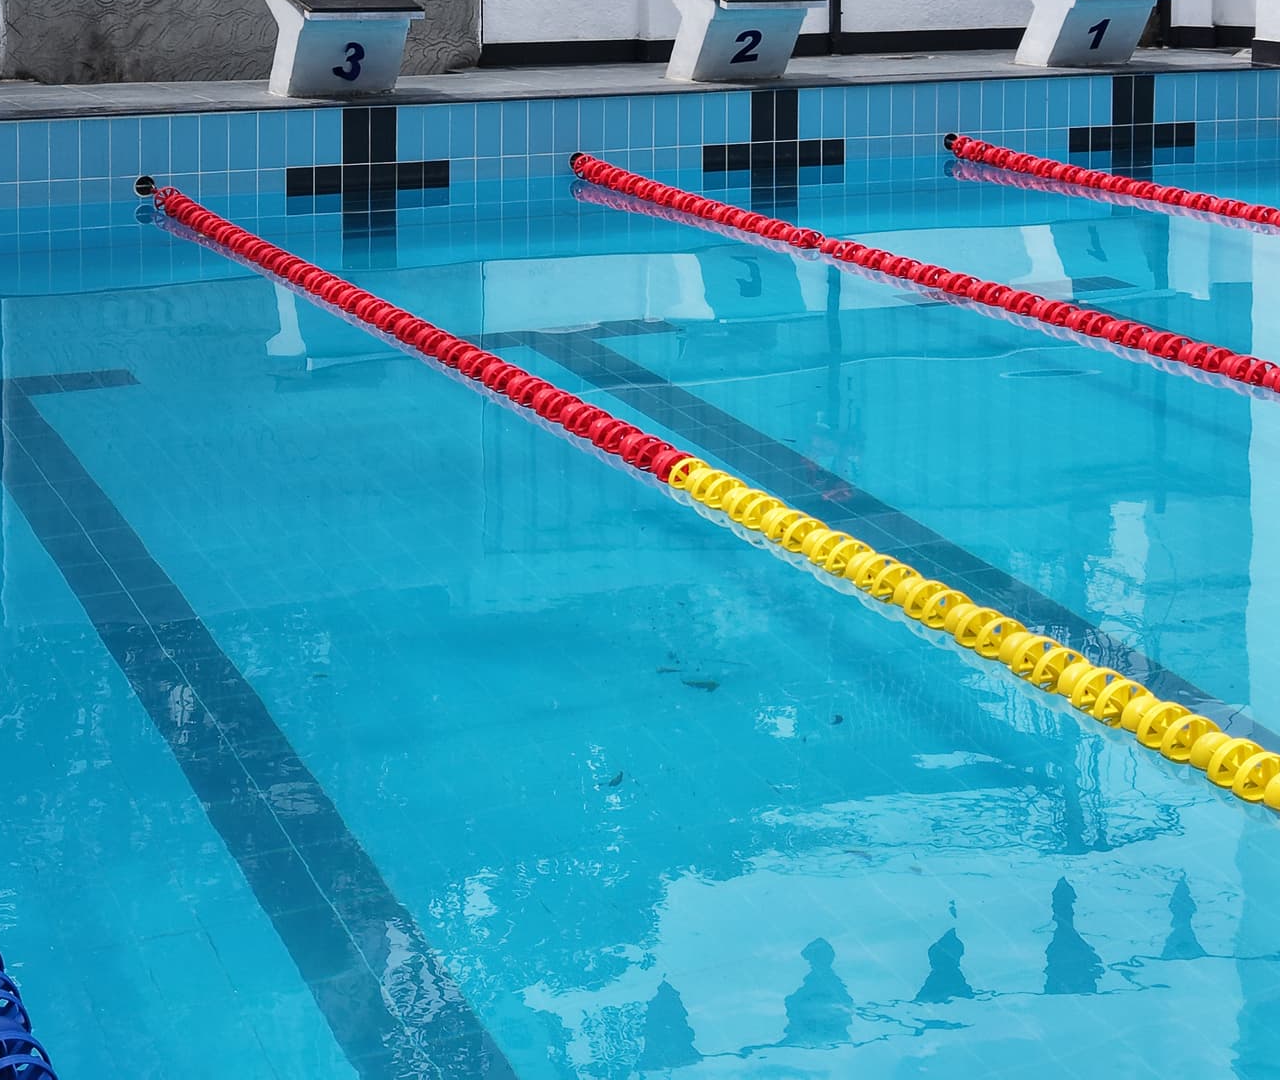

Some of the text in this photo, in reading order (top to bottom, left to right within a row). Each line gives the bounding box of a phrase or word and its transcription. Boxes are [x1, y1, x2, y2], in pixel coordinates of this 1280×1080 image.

[729, 30, 762, 64] 2
[1087, 19, 1111, 50] 1
[332, 42, 365, 81] 3
